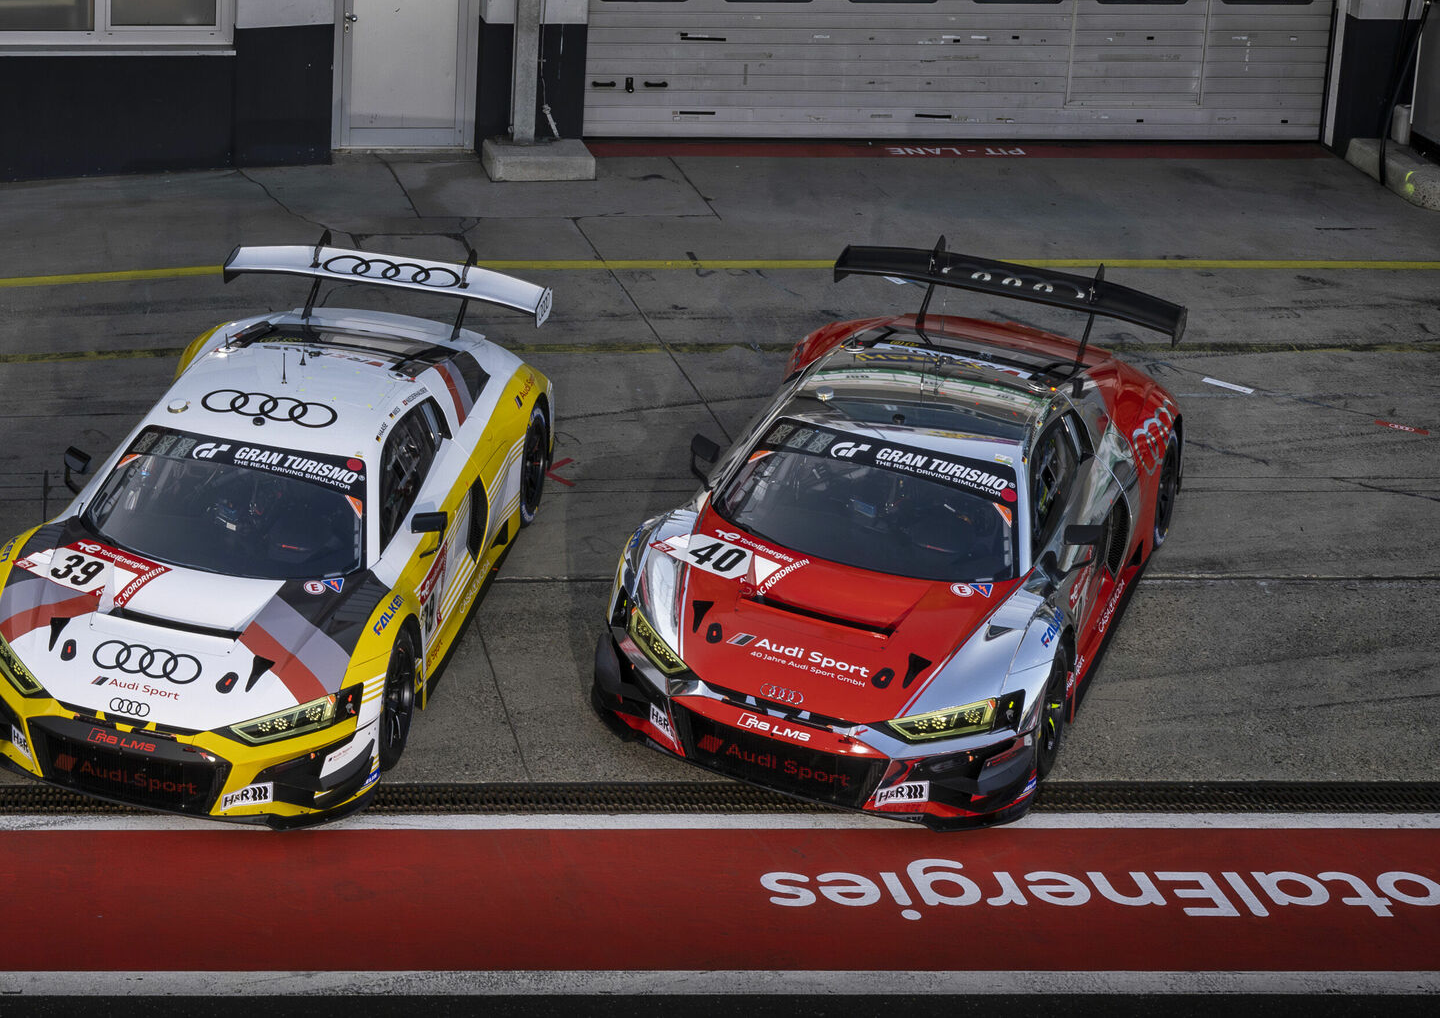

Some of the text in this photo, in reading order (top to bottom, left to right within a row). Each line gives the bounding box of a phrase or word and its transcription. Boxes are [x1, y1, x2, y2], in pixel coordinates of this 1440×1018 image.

[234, 447, 358, 484] GRAN TURISMO
[250, 462, 270, 470] REAL
[271, 466, 304, 477] DRIVING
[305, 473, 351, 490] SIMULATOR
[876, 447, 1009, 491] GRAN TURISMO
[892, 463, 915, 473] REAL
[916, 468, 951, 481] DRIVING
[952, 477, 1001, 497] SIMULATOR
[100, 549, 150, 571] TotalEnergies
[688, 542, 747, 573] 40
[740, 537, 794, 563] TotalEnergies
[50, 554, 104, 586] 39
[122, 566, 164, 601] NORDRHEIN
[764, 558, 810, 591] NORDRHEIN
[373, 594, 404, 636] FALKEN
[754, 638, 869, 677] Audi Sport
[763, 653, 786, 666] Jahre
[788, 660, 808, 671] Audi
[810, 665, 835, 678] Sport
[837, 674, 865, 688] GmbH
[108, 678, 180, 701] Audi Sport
[119, 737, 156, 752] LMS
[746, 718, 811, 742] R8 LMS
[726, 743, 850, 787] Audi Sport
[878, 786, 905, 802] H&R
[760, 859, 1440, 920] otalEnergies
